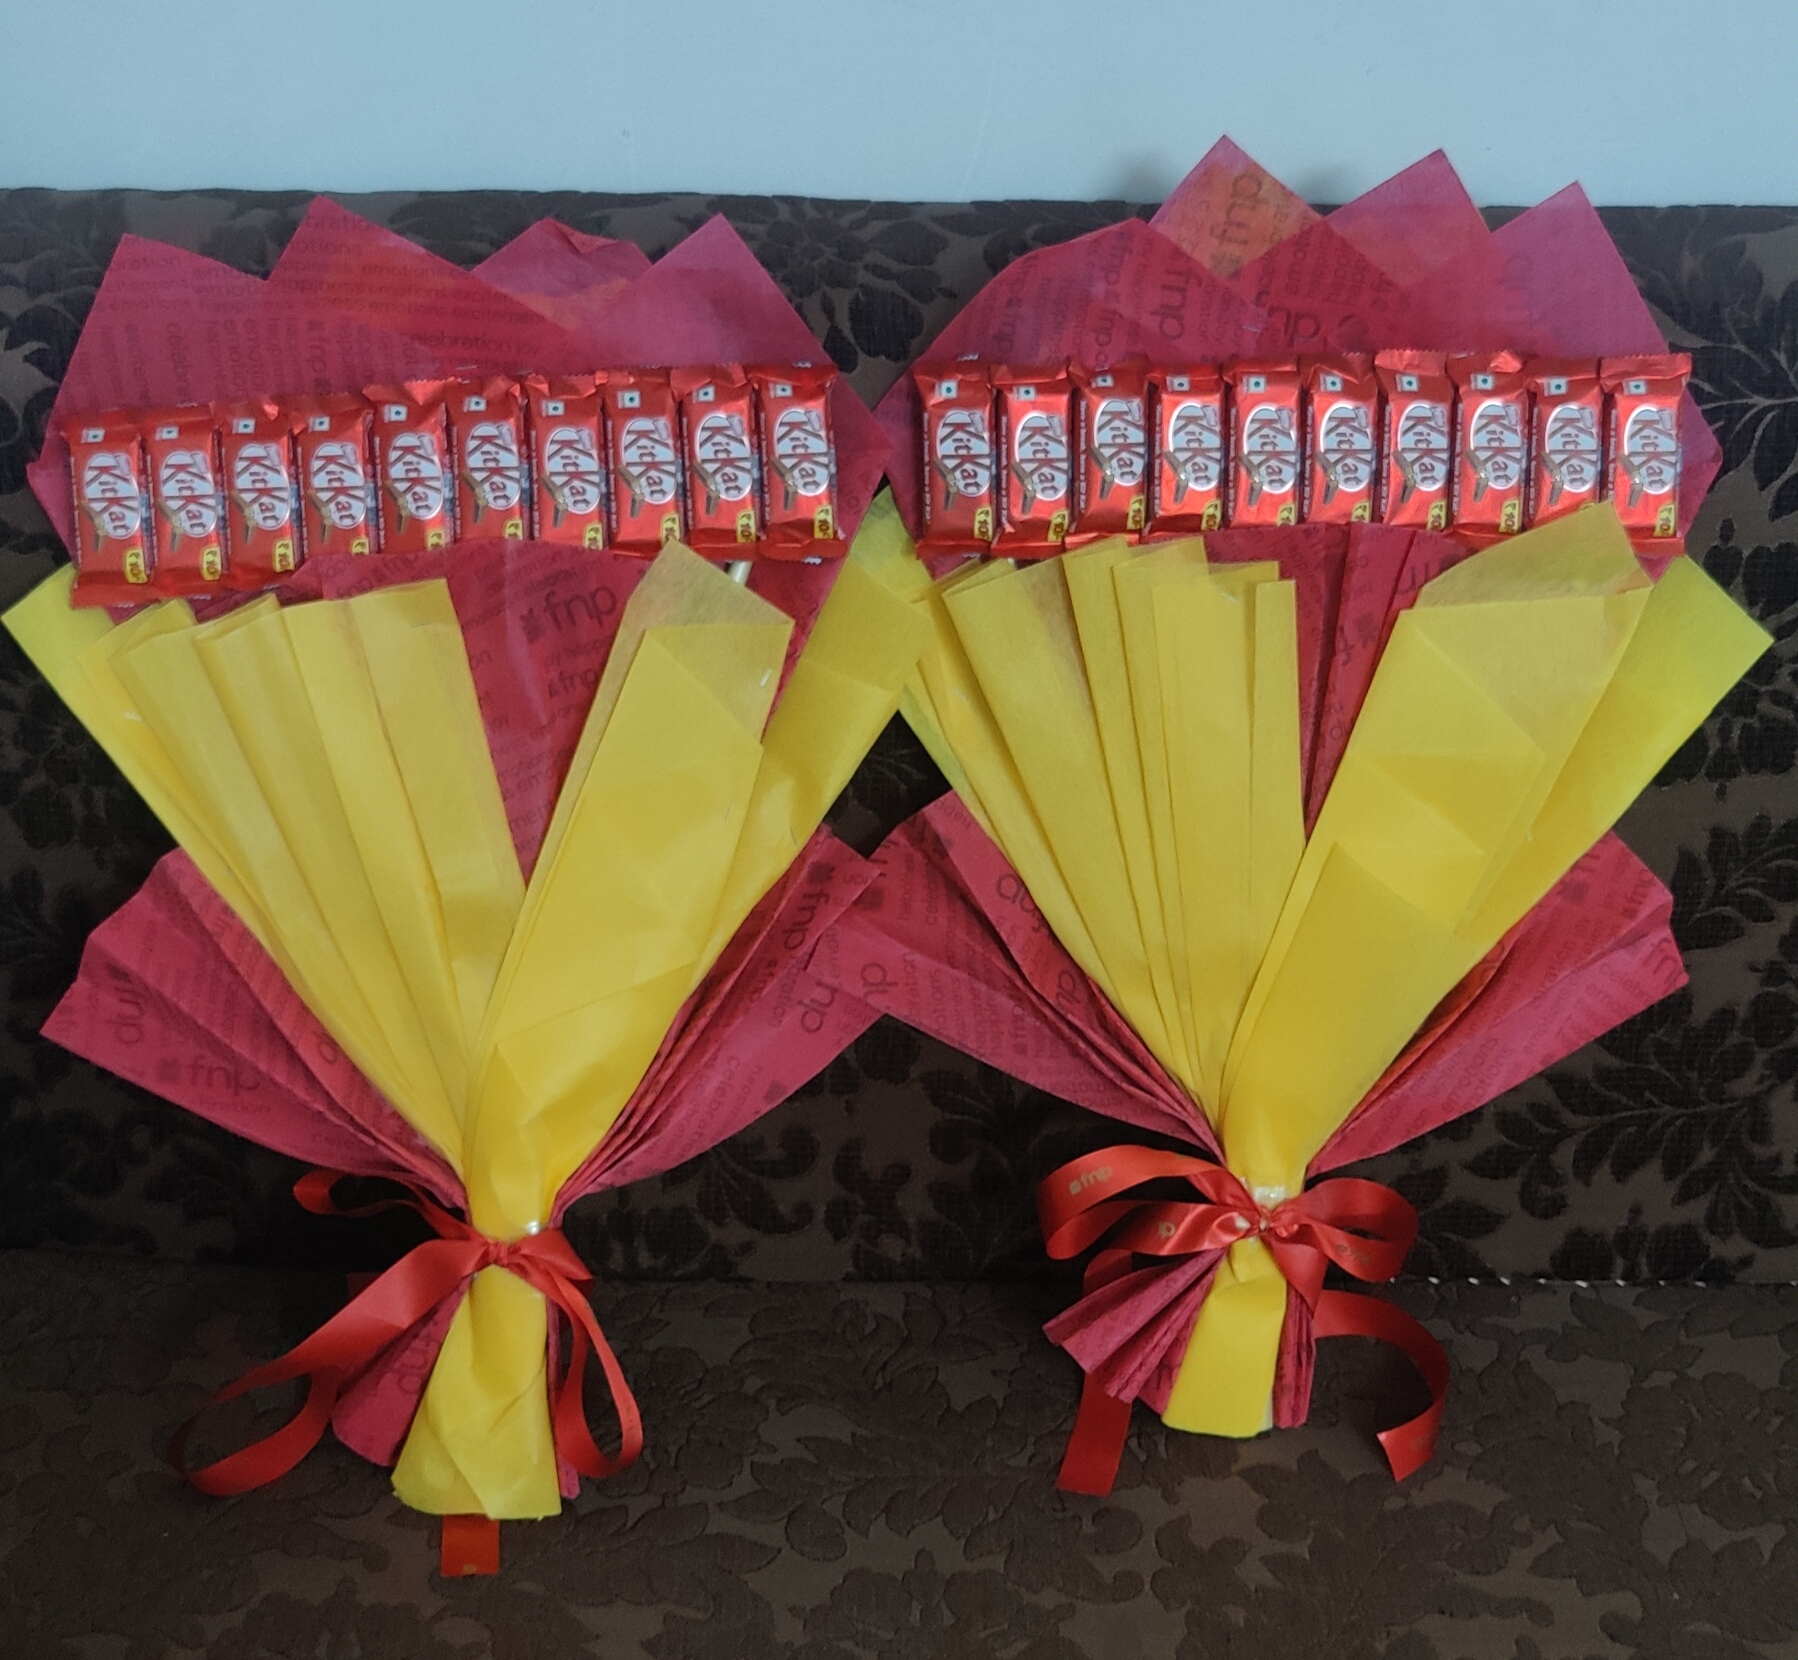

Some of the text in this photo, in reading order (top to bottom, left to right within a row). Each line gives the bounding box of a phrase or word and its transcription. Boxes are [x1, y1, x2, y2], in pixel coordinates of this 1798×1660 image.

[1148, 267, 1203, 340] fnp
[391, 445, 442, 512] KitKat
[468, 434, 520, 503] KitKat
[548, 439, 600, 508] KitKat
[624, 429, 676, 498] KitKat
[699, 426, 752, 495] KitKat
[777, 421, 830, 491] KitKat
[940, 422, 992, 491] KitKat
[1018, 426, 1068, 495] KitKat
[1098, 411, 1146, 480] KitKat
[1173, 416, 1222, 485] KitKat
[1248, 418, 1298, 487] KitKat
[1325, 416, 1374, 485] KitKat
[1402, 416, 1448, 484] KitKat
[1475, 414, 1523, 485] KitKat
[1549, 418, 1598, 486] KitKat
[1629, 419, 1678, 487] KitKat
[86, 464, 139, 531] KitKat
[163, 463, 217, 530] KitKat
[237, 456, 289, 523] KitKat
[313, 455, 366, 522] KitKat
[543, 585, 618, 631] fnp
[782, 888, 831, 951] fnp
[104, 986, 146, 1046] fnp
